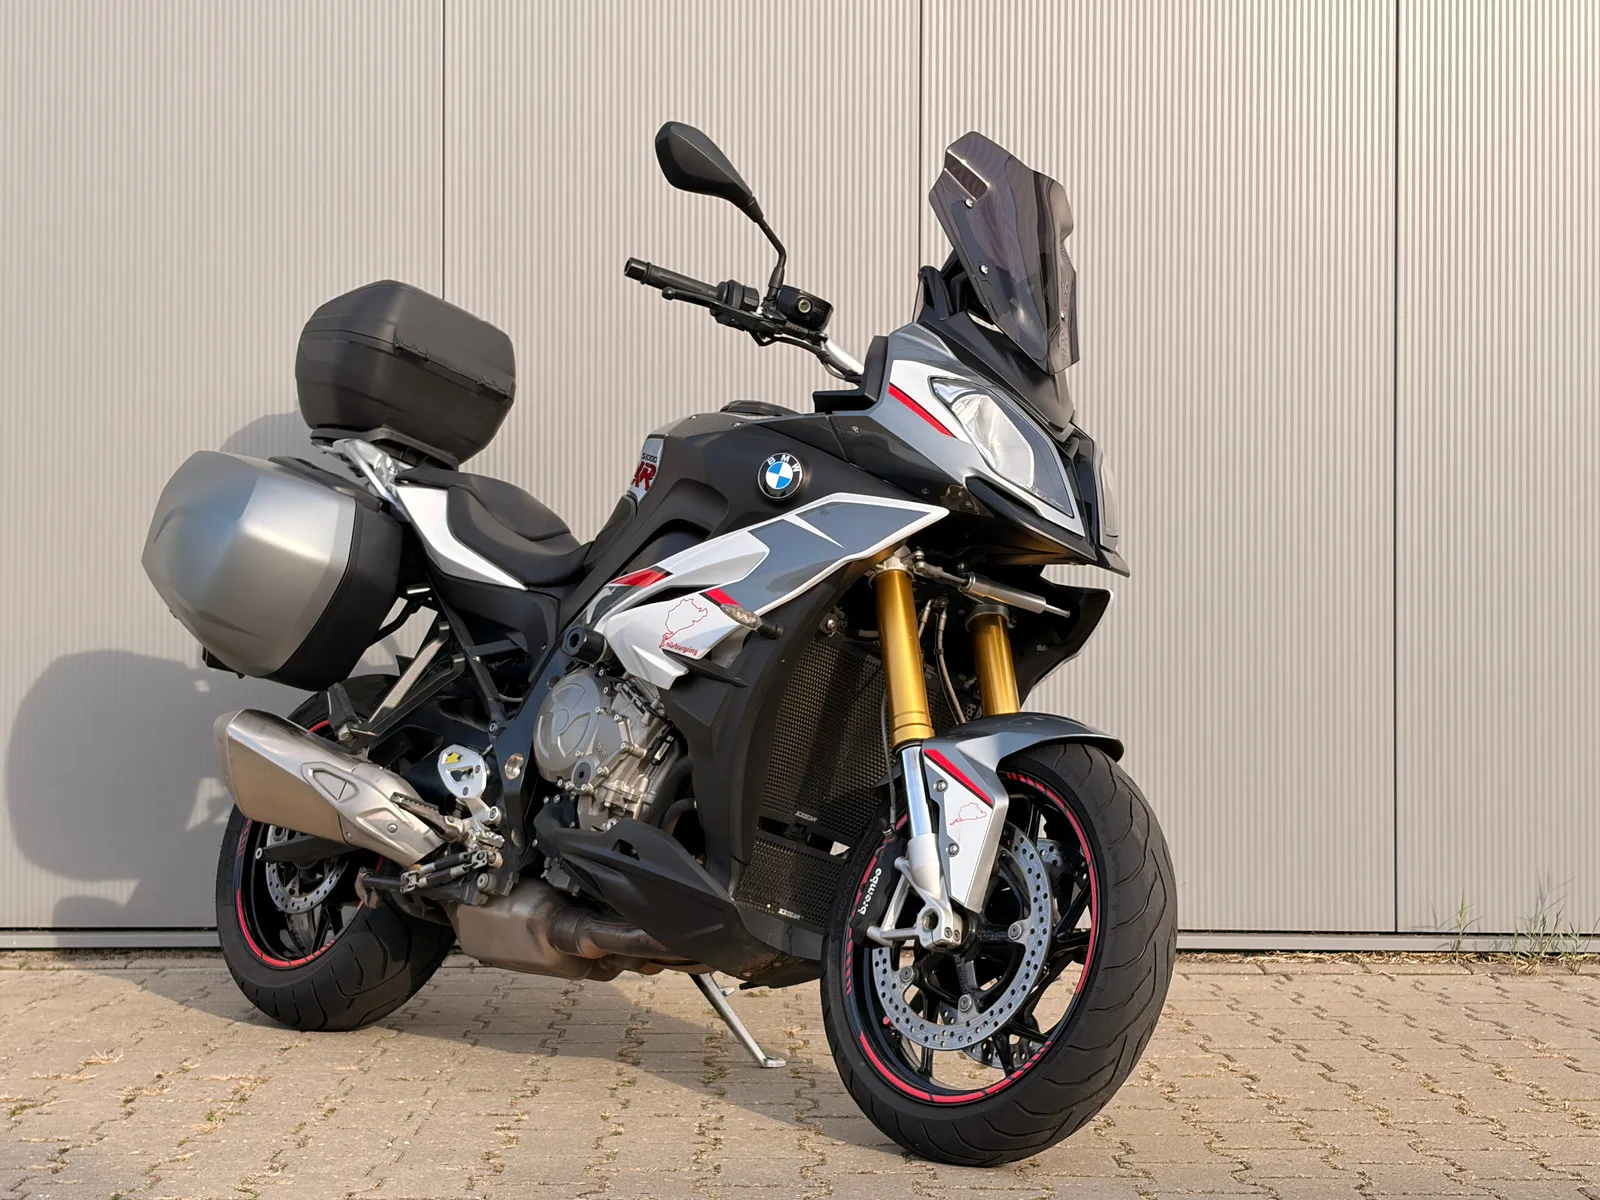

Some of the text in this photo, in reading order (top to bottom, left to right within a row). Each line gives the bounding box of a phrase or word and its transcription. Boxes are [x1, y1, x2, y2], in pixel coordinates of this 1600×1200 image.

[767, 454, 801, 472] BMW
[665, 642, 698, 656] nürburgring
[857, 867, 882, 915] brembo
